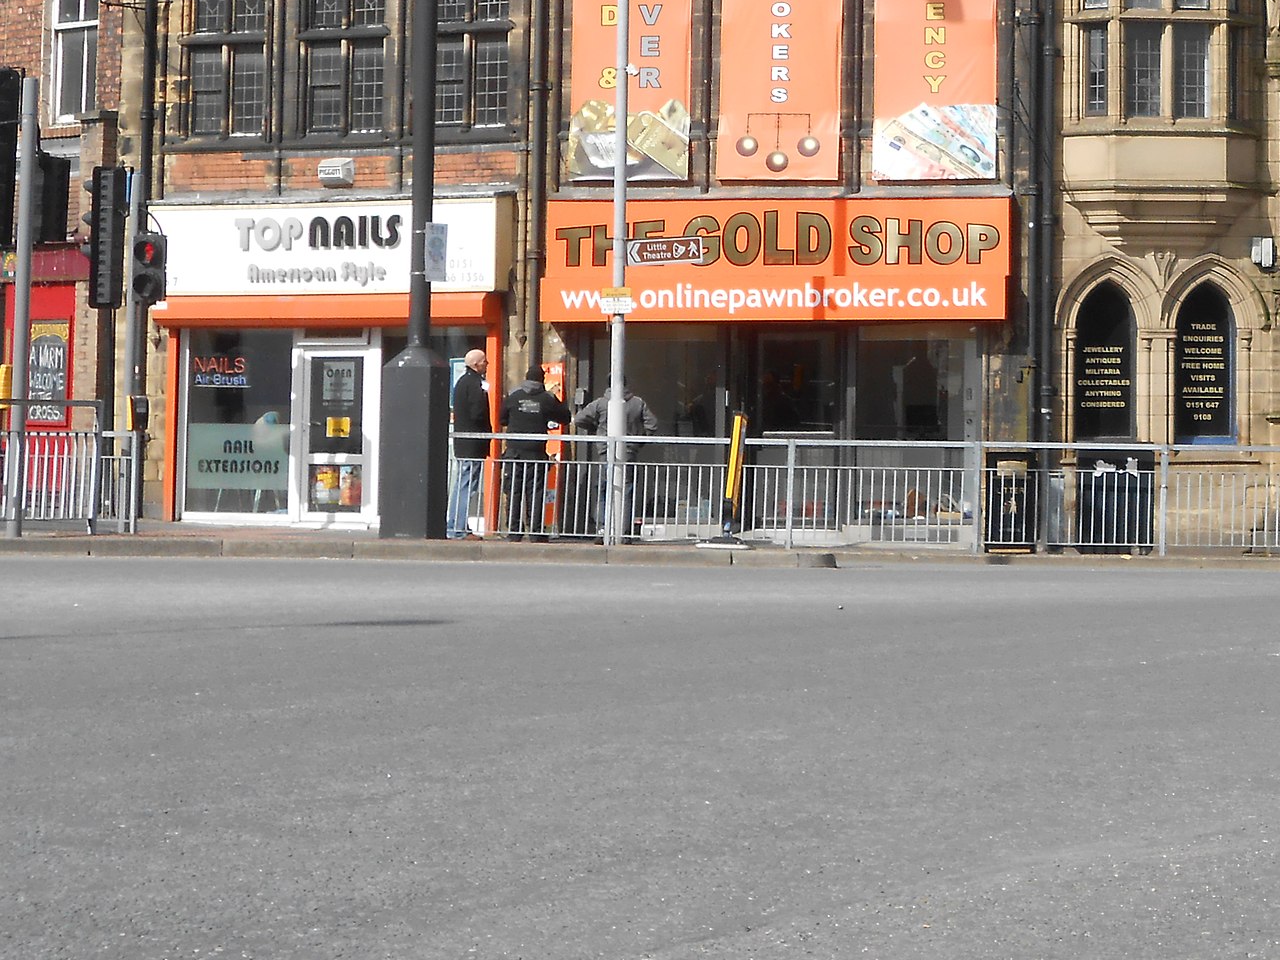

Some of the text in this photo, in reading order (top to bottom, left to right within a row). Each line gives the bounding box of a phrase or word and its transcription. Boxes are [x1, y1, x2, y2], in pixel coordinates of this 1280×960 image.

[598, 67, 618, 89] &
[235, 216, 303, 251] TOP
[308, 215, 403, 250] NAILS
[683, 210, 831, 267] GOLD
[848, 214, 1001, 266] SHOP
[646, 242, 667, 251] Little
[642, 251, 672, 260] Theatre
[449, 259, 473, 269] 0151
[247, 261, 387, 286] American Style
[560, 281, 987, 314] ww.onlinepawnbroker.co.uk
[29, 344, 64, 369] A WARM
[194, 356, 246, 374] NAILS
[194, 373, 247, 385] Air Brush
[326, 368, 352, 378] OPEN
[1185, 401, 1220, 409] 0151 647
[223, 439, 255, 454] NAIL
[197, 459, 280, 474] EXTENSIONS
